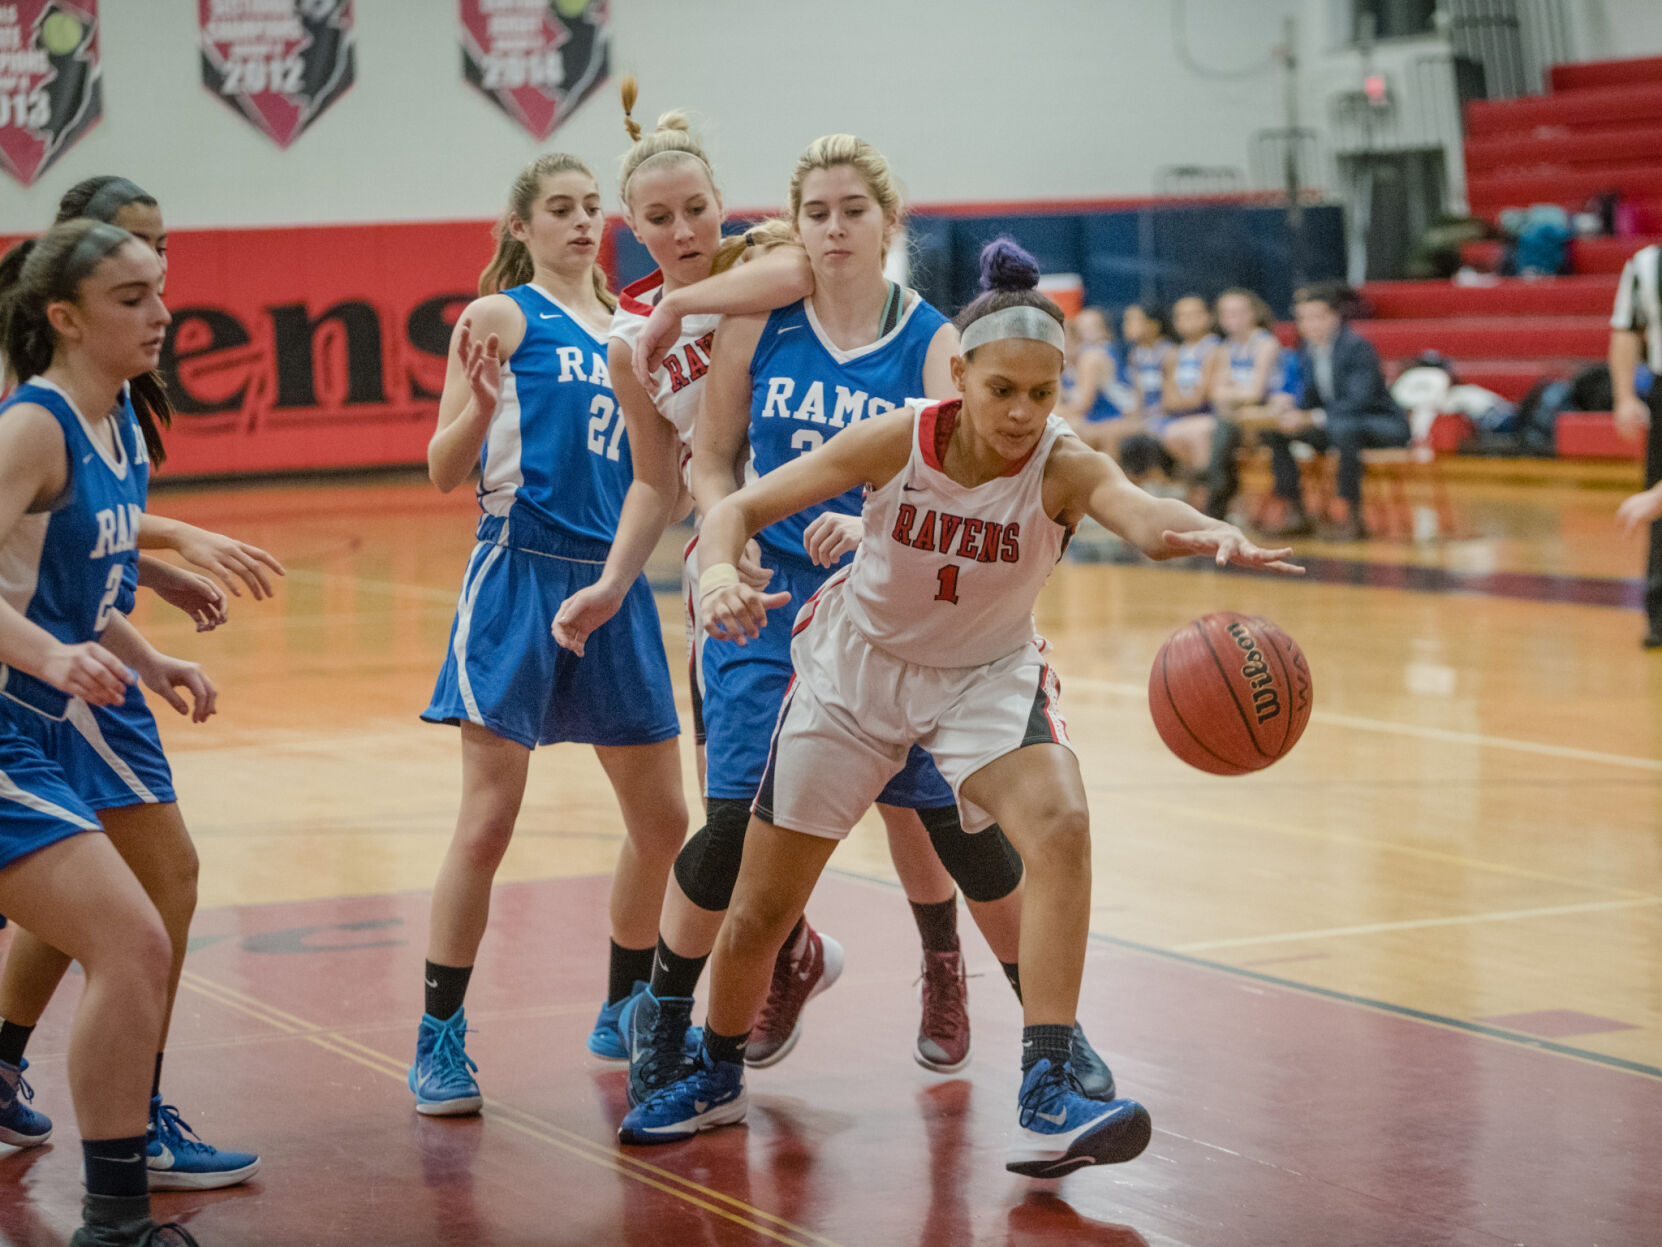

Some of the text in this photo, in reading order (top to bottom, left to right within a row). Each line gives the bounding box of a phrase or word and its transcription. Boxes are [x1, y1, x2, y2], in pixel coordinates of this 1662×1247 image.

[222, 55, 306, 95] 2012
[587, 393, 626, 462] 21
[891, 503, 1020, 563] RAVENS
[934, 564, 960, 605] 1
[1225, 622, 1281, 725] Wilson
